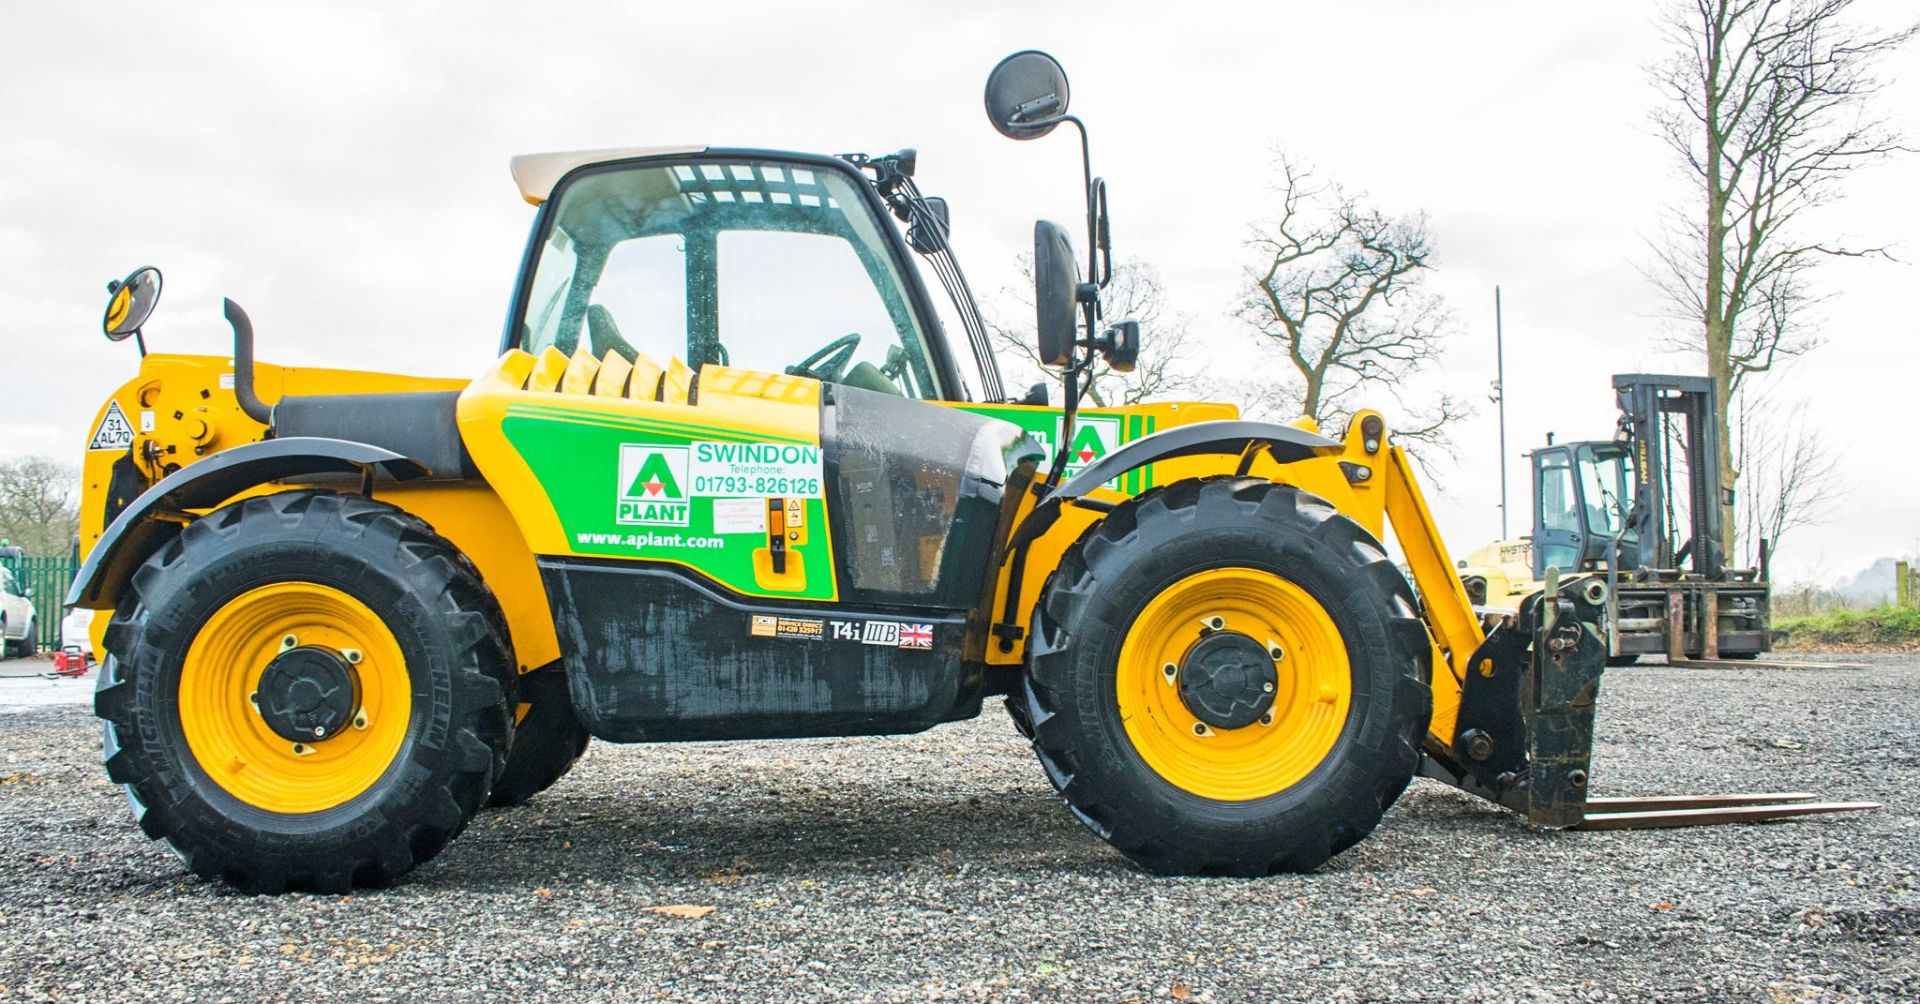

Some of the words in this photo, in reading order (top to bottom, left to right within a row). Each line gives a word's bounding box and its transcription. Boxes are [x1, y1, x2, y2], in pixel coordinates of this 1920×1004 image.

[107, 419, 122, 431] 31
[697, 443, 817, 465] SWINDON
[1639, 439, 1648, 485] HYSTER
[730, 464, 785, 475] Telephone:
[695, 475, 818, 495] 01793-826126
[619, 503, 687, 521] PLANT
[577, 531, 724, 550] www.aplant.com
[830, 621, 861, 640] T4i
[865, 623, 897, 643] IIIB
[138, 651, 171, 775] MICHELIN
